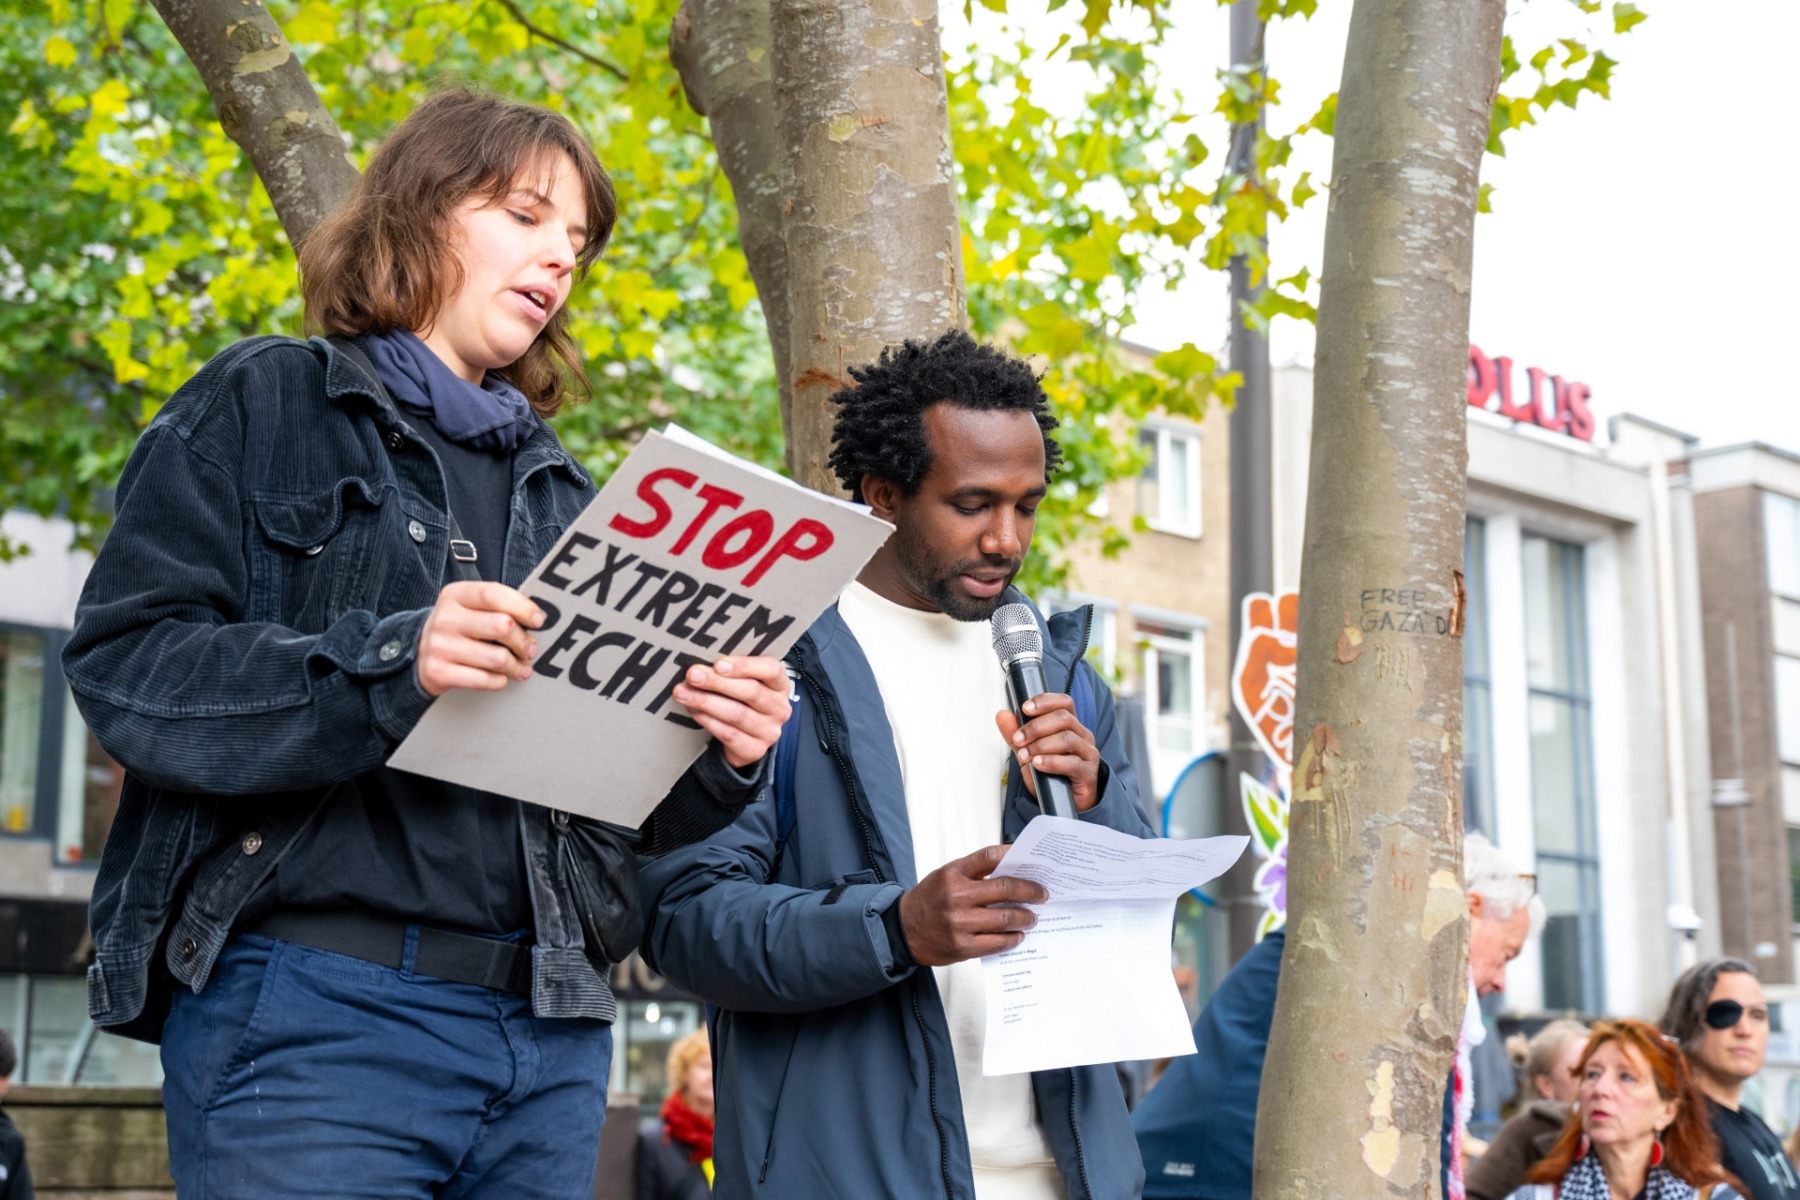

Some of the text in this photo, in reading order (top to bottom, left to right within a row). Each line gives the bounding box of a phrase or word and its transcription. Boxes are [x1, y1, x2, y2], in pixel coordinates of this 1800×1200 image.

[608, 468, 834, 588] STOP
[538, 531, 796, 657] EXTREEM
[1360, 609, 1425, 634] GAZA
[1361, 588, 1426, 609] FREE
[525, 595, 714, 730] ECHT
